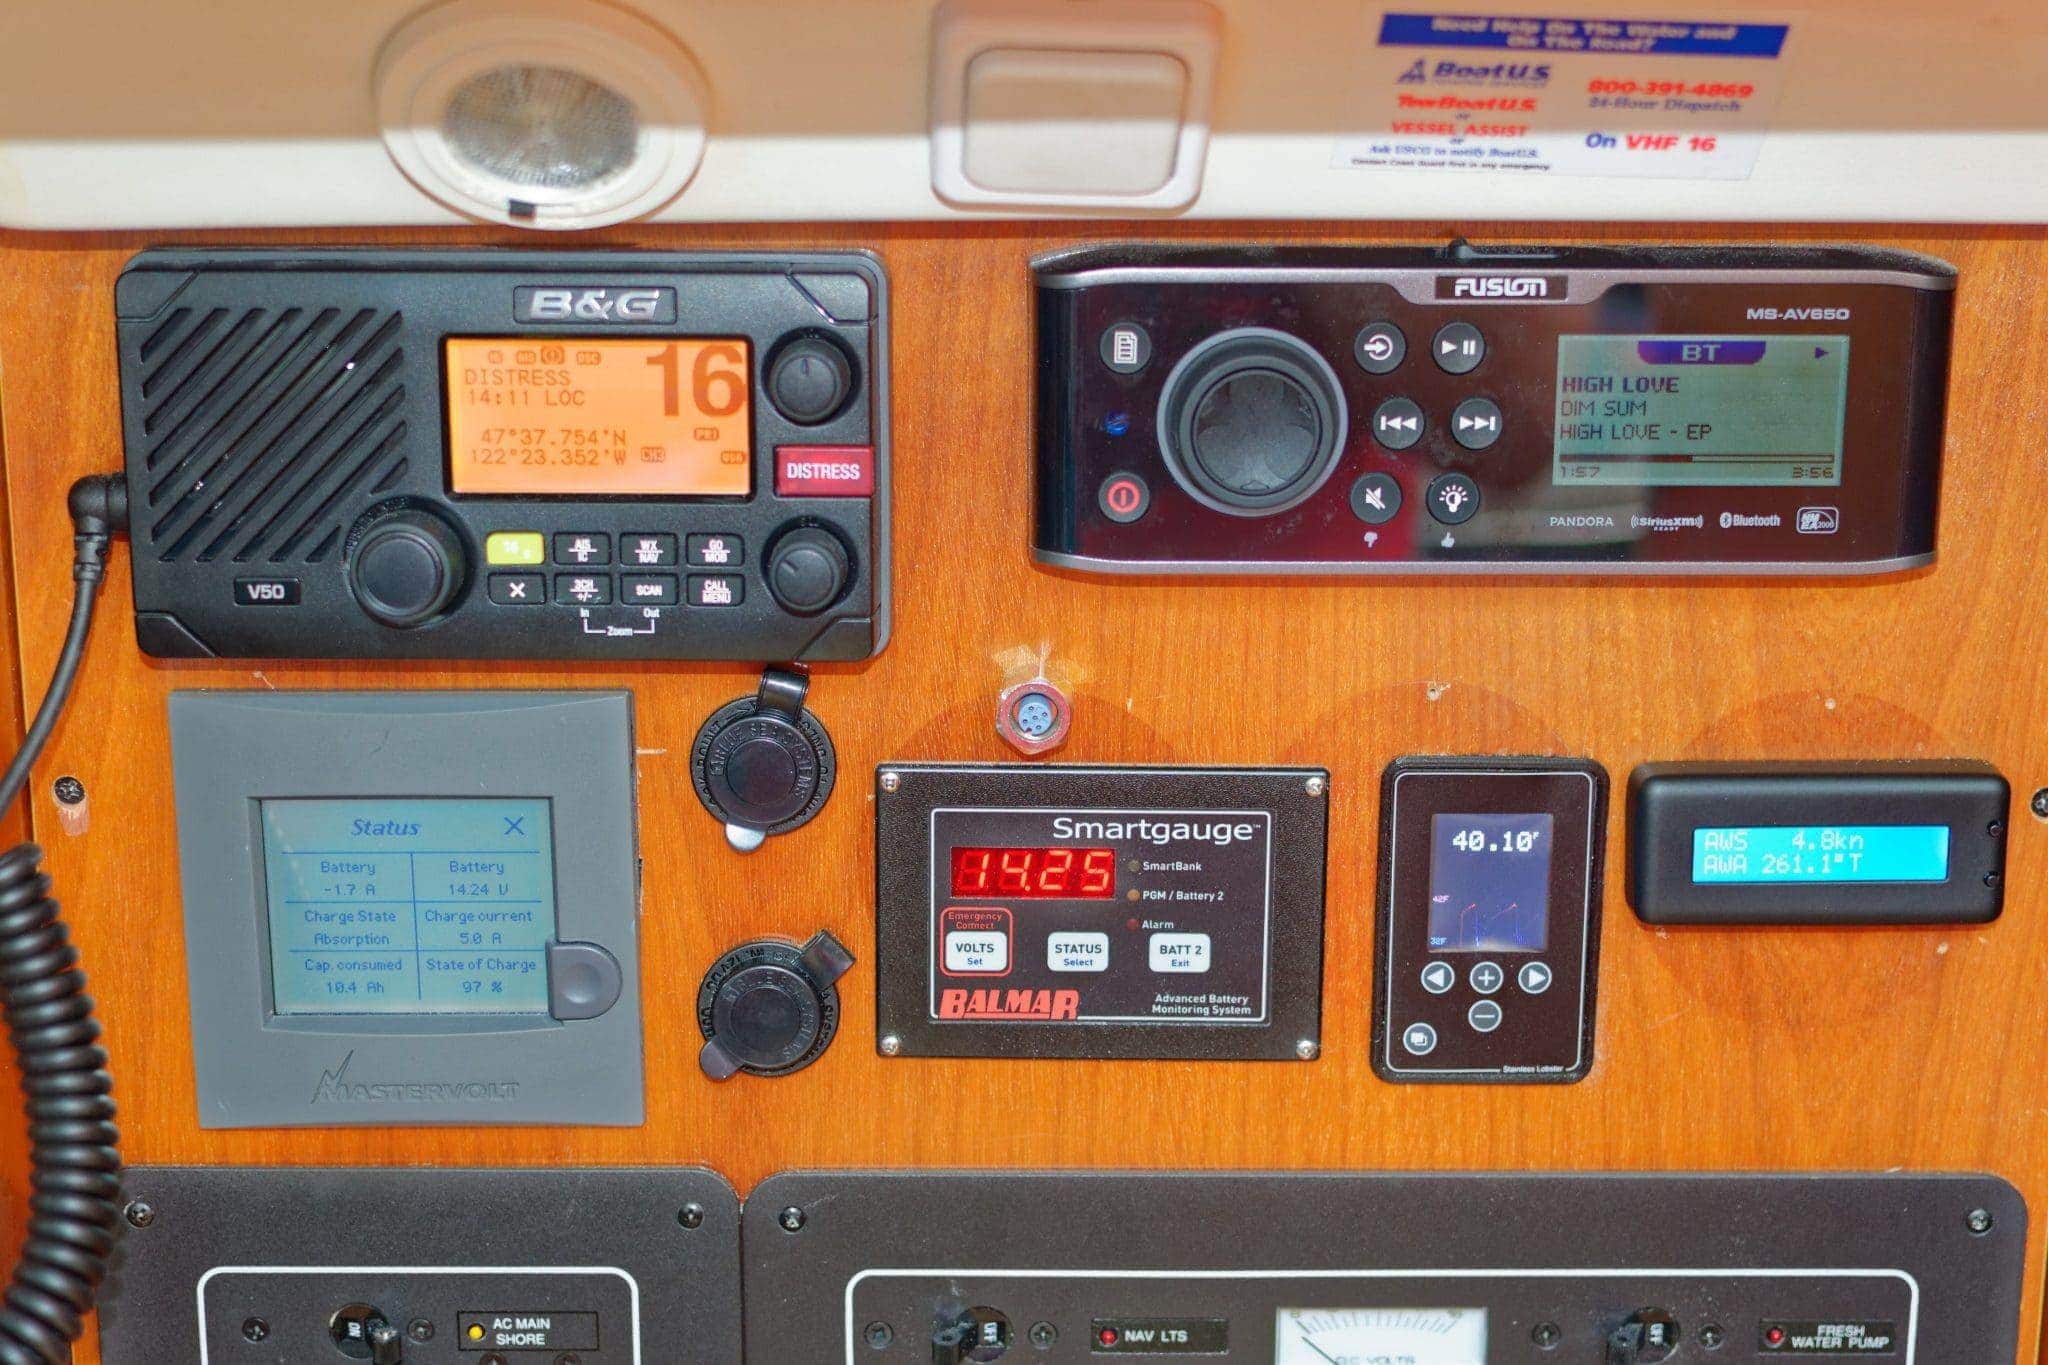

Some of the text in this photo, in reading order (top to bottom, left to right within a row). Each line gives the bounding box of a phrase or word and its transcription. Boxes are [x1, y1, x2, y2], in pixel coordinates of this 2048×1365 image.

[1588, 79, 1754, 98] 800-391-4869
[1664, 99, 1741, 112] Dispatch
[1392, 122, 1529, 136] VESSEL ASSIST
[1586, 133, 1717, 151] On VHF 16
[1454, 277, 1548, 298] FUSION
[531, 289, 661, 321] B&G
[1746, 308, 1850, 321] MS-AV650
[1681, 344, 1722, 362] BT
[464, 369, 572, 386] DISTRESS
[646, 343, 748, 418] 16
[1561, 376, 1680, 393] HIGH LOVE
[468, 390, 586, 406] 14:11 LOC
[1560, 400, 1648, 417] DIM SUM
[1560, 424, 1603, 441] HIGH
[1611, 424, 1661, 441] LOVE
[1686, 424, 1712, 441] EP
[786, 462, 861, 480] DISTRESS
[1560, 466, 1601, 479] 1:57
[1792, 466, 1835, 479] 3:56
[1550, 516, 1615, 527] PANDORA
[1732, 513, 1781, 528] Bluetooth
[640, 540, 658, 550] WX
[639, 552, 659, 563] NAV
[246, 584, 285, 599] V50
[636, 585, 663, 596] SCAN
[704, 580, 727, 591] CALL
[702, 591, 731, 604] MENU
[580, 608, 589, 617] In
[643, 608, 660, 618] Out
[606, 626, 633, 636] Zoom
[351, 818, 423, 837] Status
[1704, 831, 1865, 851] AWS 4.8kn
[320, 860, 376, 876] Battery
[449, 860, 505, 876] Battery
[1143, 862, 1202, 871] SmartBank
[1703, 854, 1748, 874] AWA
[977, 850, 1113, 892] 14.25
[324, 883, 375, 896] -1.7 A
[448, 883, 489, 896] 14.24
[1143, 891, 1166, 900] PGM
[1176, 891, 1214, 902] Battery
[1217, 891, 1224, 901] 2
[304, 910, 397, 926] Charge State
[425, 910, 533, 926] Charge current
[948, 912, 1002, 922] Emergency
[1142, 920, 1174, 929] Alarm
[314, 932, 389, 949] Absorption
[459, 932, 502, 945] 5.0 A
[956, 943, 995, 953] VOLTS
[1055, 944, 1102, 953] STATUS
[1159, 945, 1202, 955] BATT 2
[337, 958, 403, 971] consumed
[426, 958, 537, 974] State of Charge
[967, 957, 983, 965] Set
[1063, 958, 1094, 966] Select
[1171, 959, 1190, 967] Exit
[326, 981, 385, 993] 10.4 Ah
[462, 981, 503, 993] 97 %
[938, 988, 1080, 1020] BALMAR
[1155, 994, 1249, 1005] Advanced Battery
[1152, 1005, 1252, 1016] Monitoring System
[312, 1063, 520, 1104] MASTERVOLT
[492, 1317, 551, 1330] AC MAIN
[1125, 1330, 1188, 1342] NAV LTS
[1817, 1325, 1866, 1338] FRESH
[495, 1333, 546, 1346] SHORE
[1791, 1336, 1890, 1349] WATER PUMP
